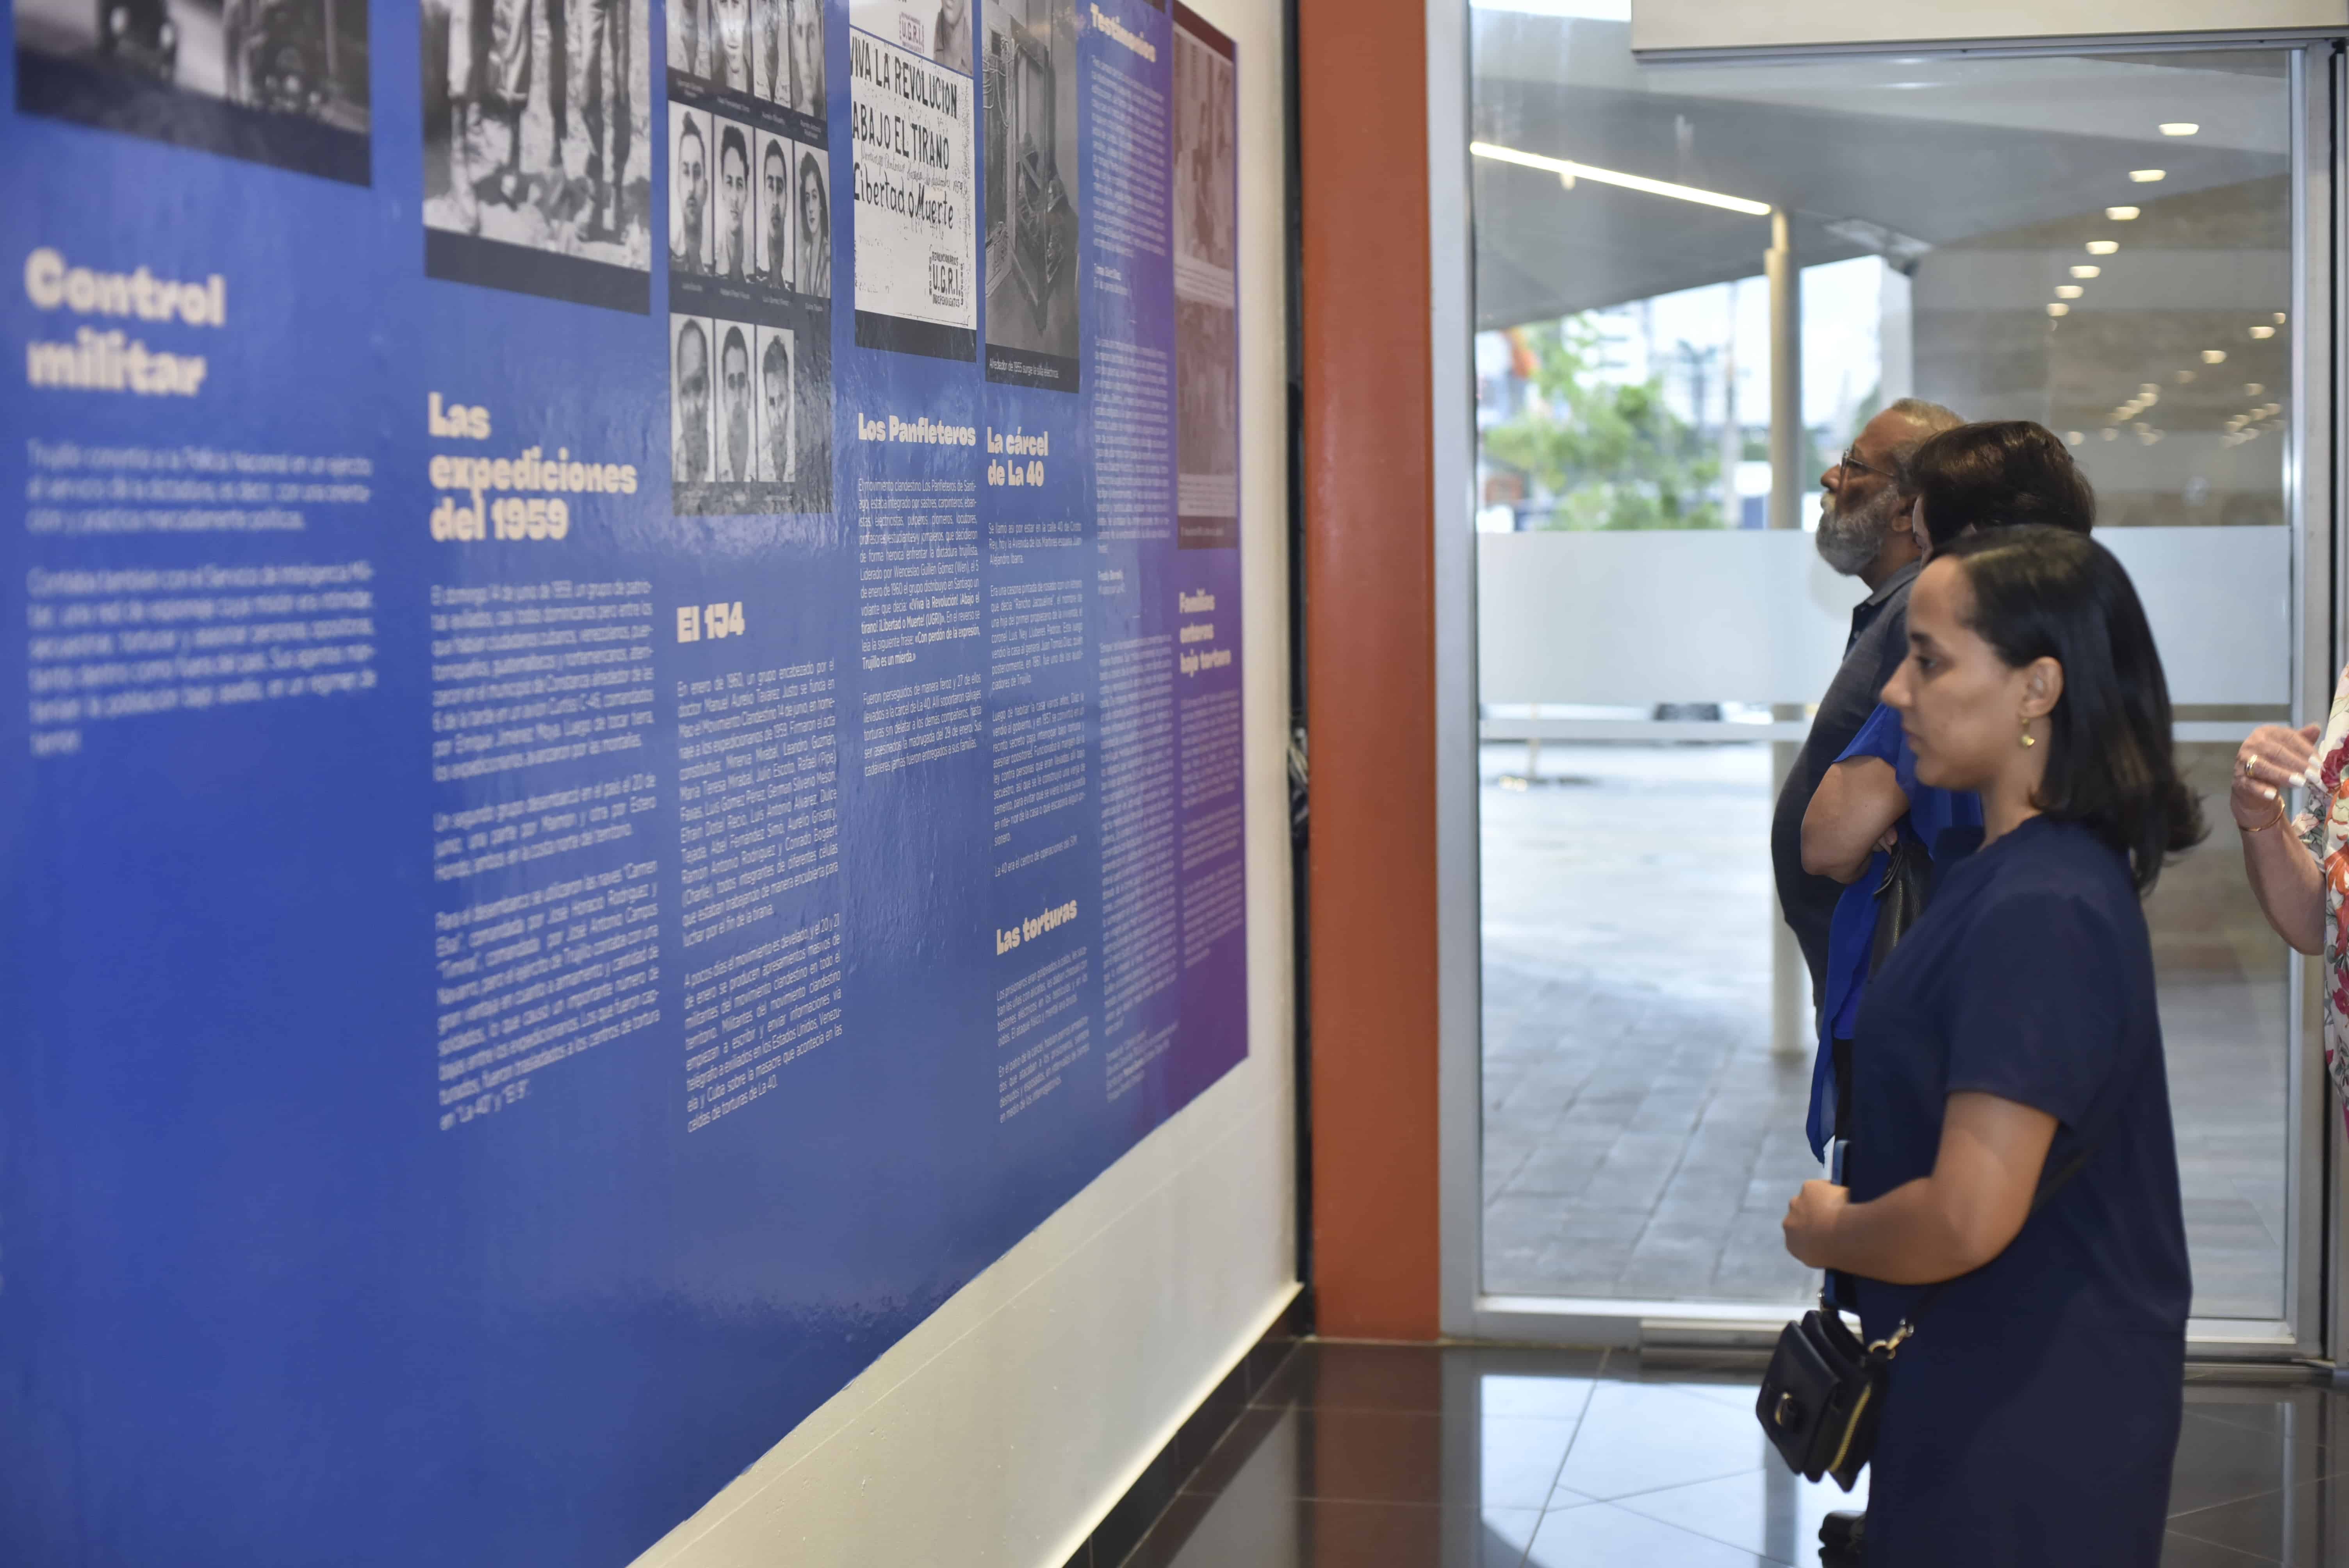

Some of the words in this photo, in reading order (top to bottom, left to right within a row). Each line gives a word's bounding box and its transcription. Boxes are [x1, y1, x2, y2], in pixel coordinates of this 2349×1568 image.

[875, 48, 890, 91] LA
[895, 56, 957, 119] REVOLUCION
[852, 101, 891, 150] ABAJO
[895, 115, 909, 158] EL
[911, 123, 949, 170] TIRANO
[854, 162, 905, 216] Libertad
[908, 191, 914, 219] o
[916, 182, 954, 229] Muerte
[26, 249, 225, 326] Control
[933, 264, 961, 297] U.G.R.I.
[28, 326, 206, 395] militar
[429, 392, 490, 439] Las
[858, 413, 886, 441] Los
[889, 415, 976, 446] Panfleteros
[987, 427, 1003, 454] La
[1006, 427, 1048, 456] cárcel
[430, 446, 637, 501] expediciones
[988, 459, 1005, 486] de
[1008, 460, 1024, 486] La
[1027, 461, 1044, 486] 40
[431, 498, 486, 541] del
[492, 498, 569, 540] 1959
[677, 606, 700, 643] El
[997, 927, 1020, 955] Las
[1023, 900, 1077, 941] torturas
